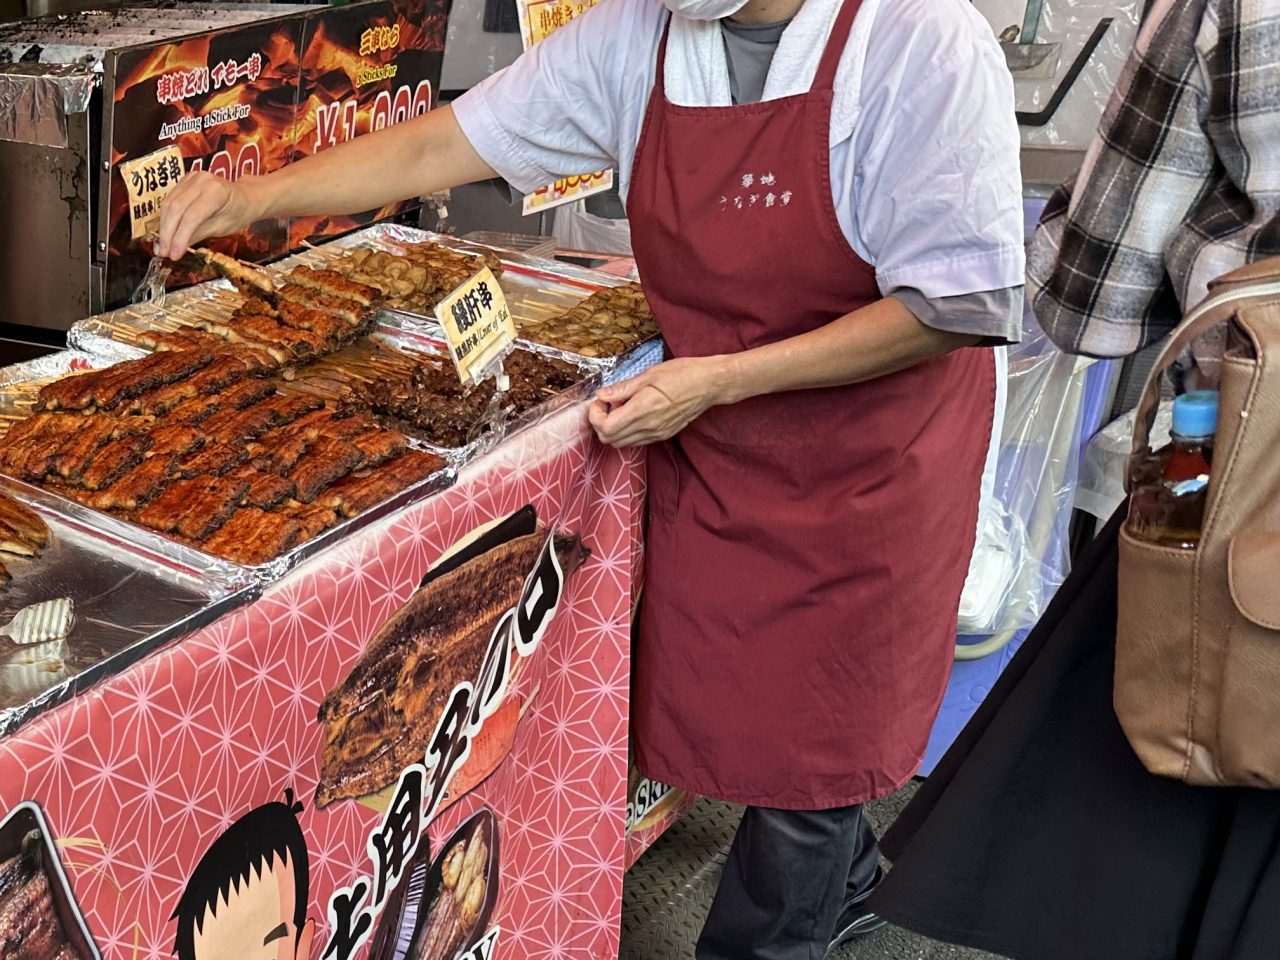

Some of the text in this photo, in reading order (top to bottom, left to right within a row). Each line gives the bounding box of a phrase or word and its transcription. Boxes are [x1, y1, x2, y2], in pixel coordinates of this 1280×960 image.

[159, 117, 201, 139] Anything
[233, 105, 250, 119] For
[131, 155, 181, 196] うなぎ串
